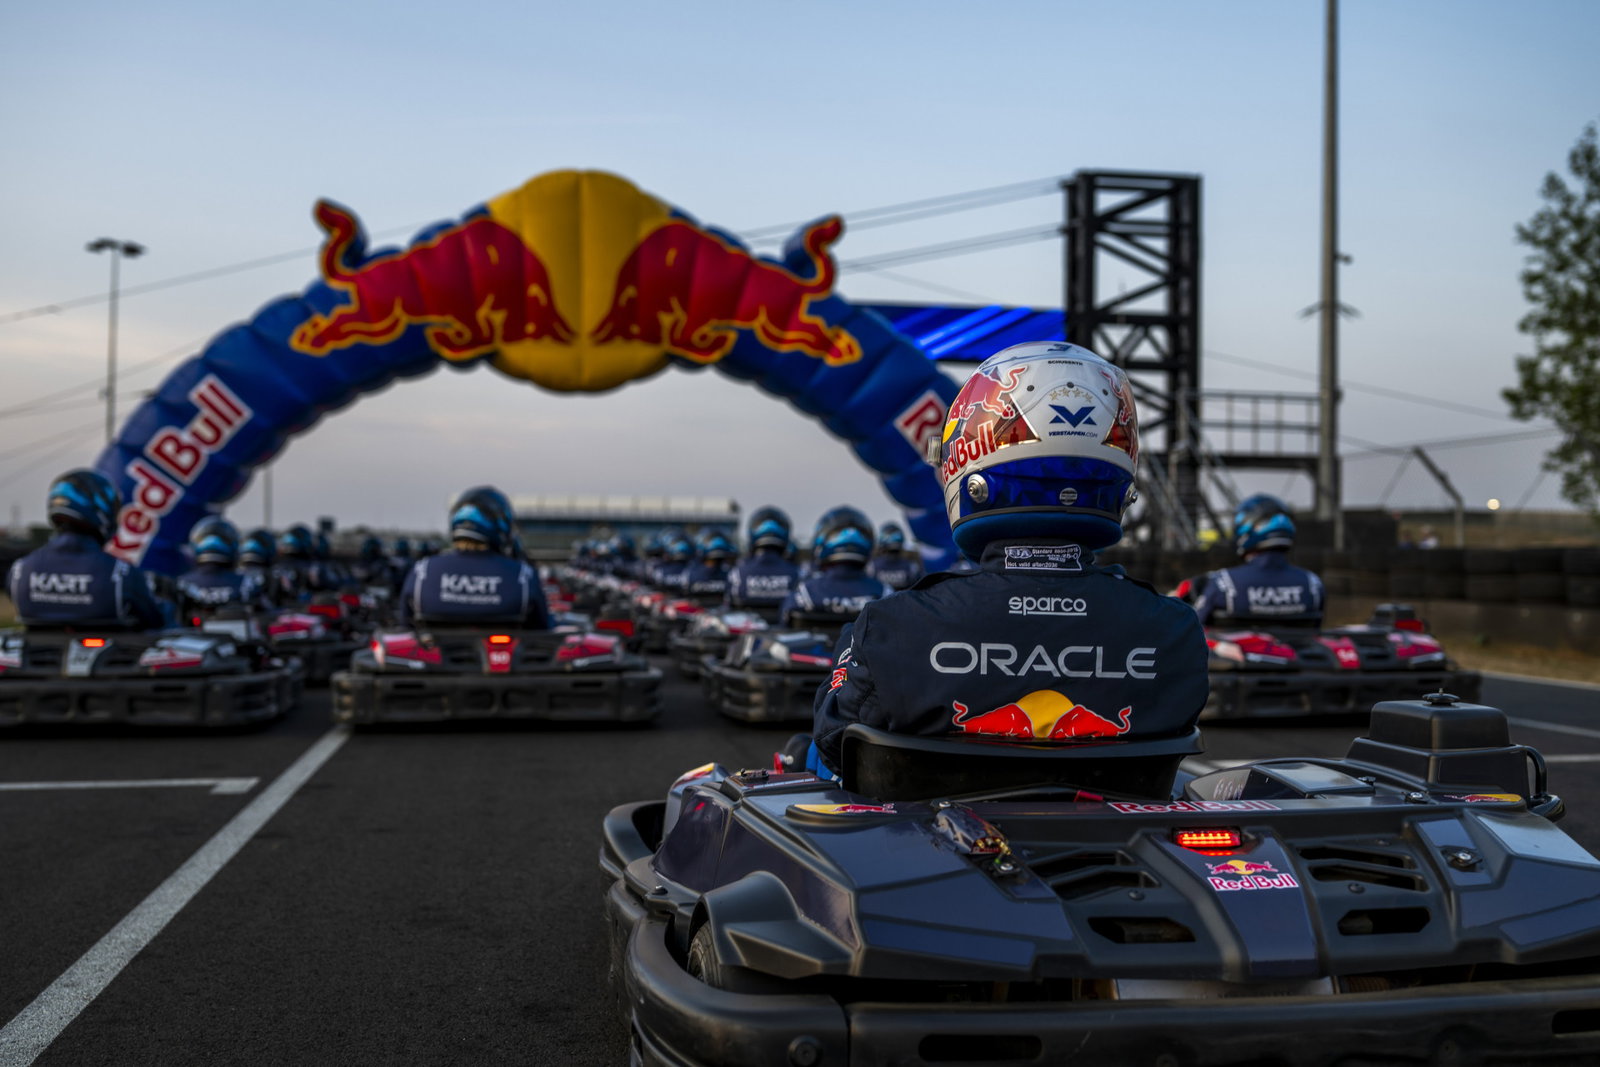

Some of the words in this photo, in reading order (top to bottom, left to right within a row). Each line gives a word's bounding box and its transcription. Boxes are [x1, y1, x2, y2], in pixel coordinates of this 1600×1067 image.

[148, 376, 252, 482] Bull
[1048, 430, 1098, 438] VERSTAPPEN.COM
[955, 420, 996, 468] Bull
[30, 573, 93, 593] KART
[441, 574, 502, 593] KART
[1248, 586, 1303, 605] KART
[1009, 596, 1087, 616] sparco
[929, 641, 1157, 680] ORACLE
[1108, 801, 1201, 814] Red
[1191, 801, 1282, 812] Bull
[1207, 876, 1257, 892] Red
[1250, 872, 1300, 889] Bull
